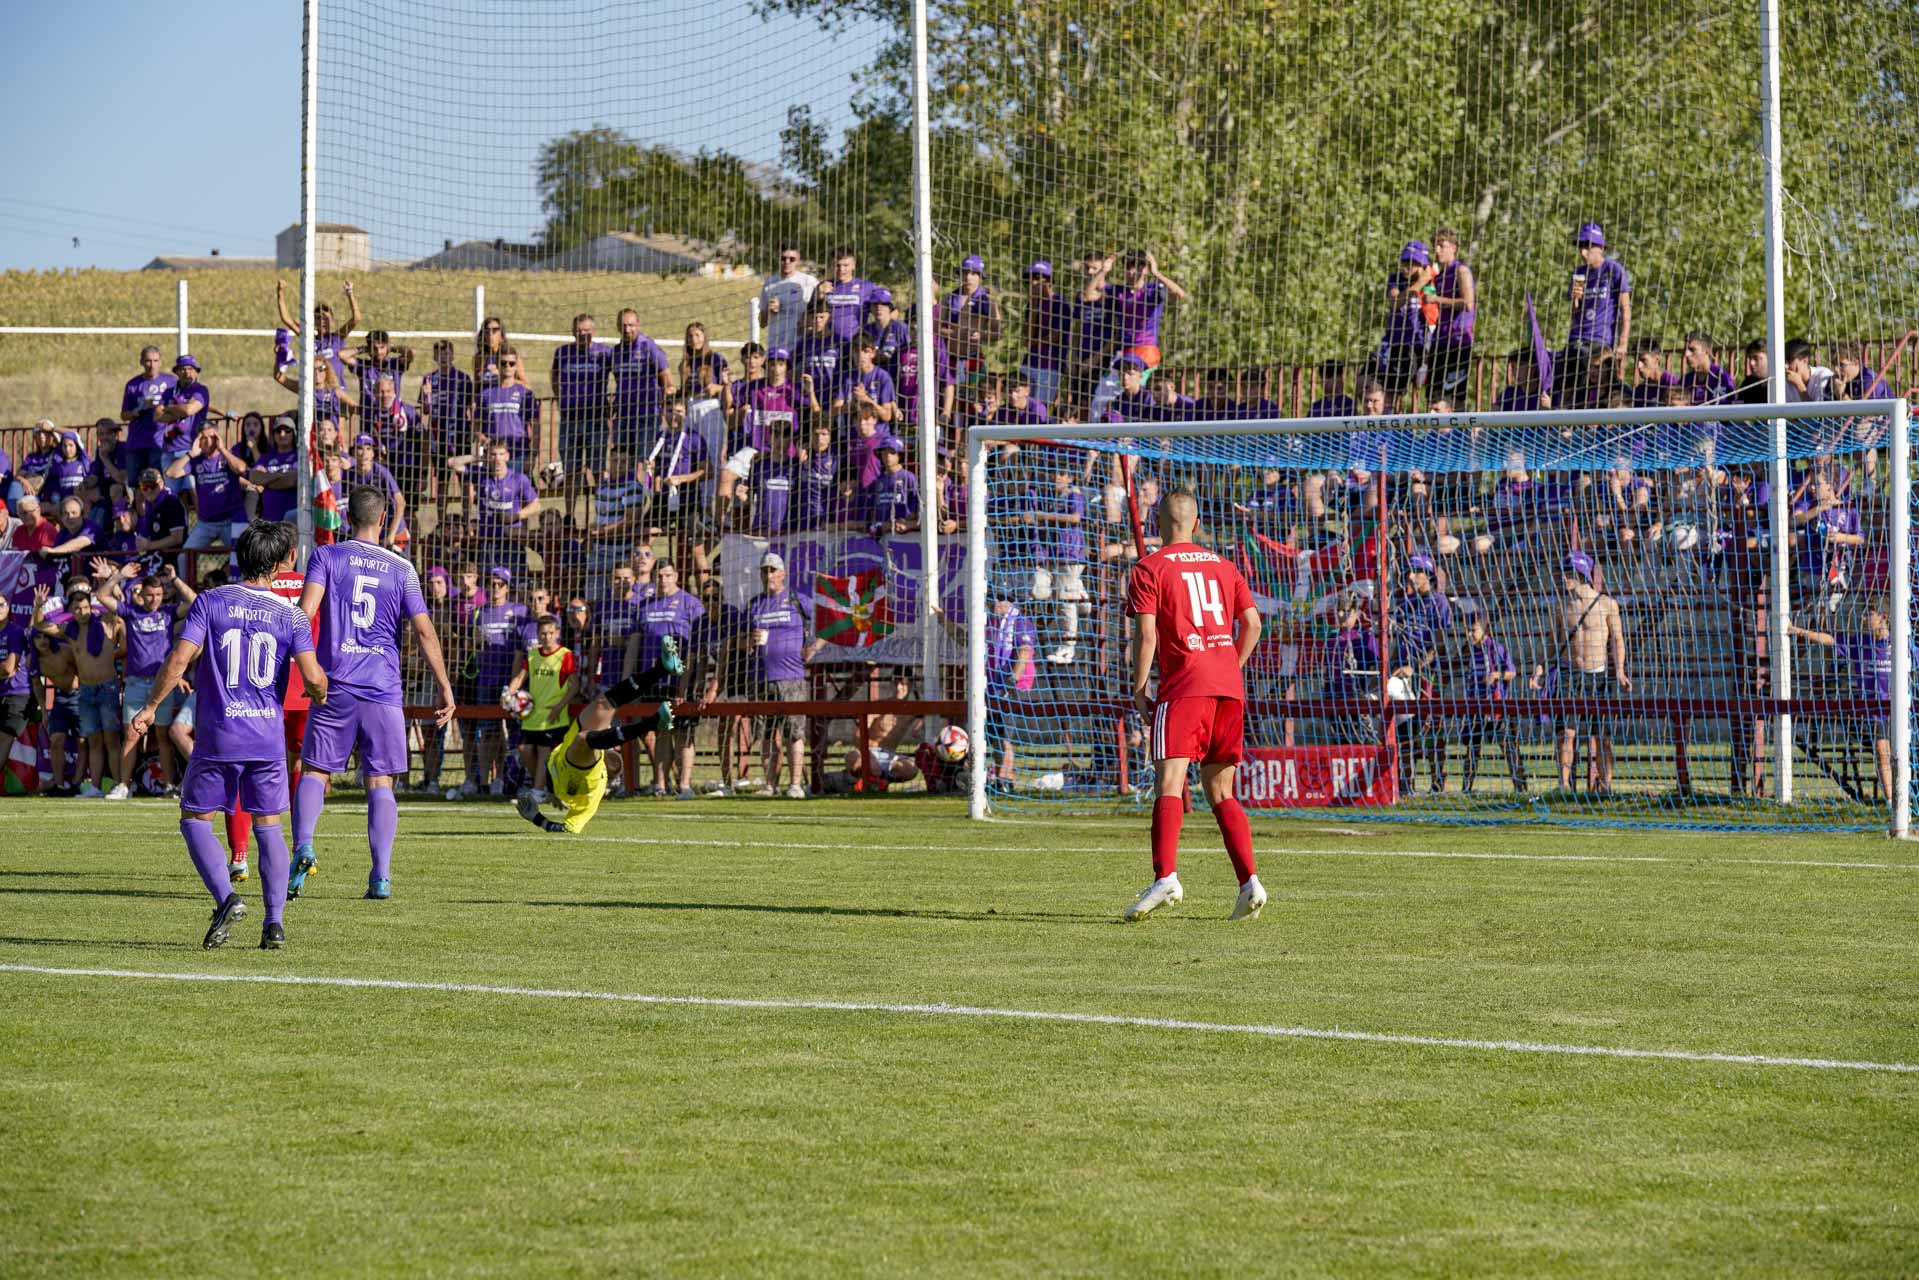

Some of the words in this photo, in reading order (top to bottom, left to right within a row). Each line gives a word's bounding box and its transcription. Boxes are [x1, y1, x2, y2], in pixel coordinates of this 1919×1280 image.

[349, 555, 389, 573] SANTURTZI
[228, 605, 273, 624] SANTURTZI
[351, 574, 379, 628] 5
[1181, 572, 1225, 627] 14
[220, 628, 278, 689] 10
[1235, 759, 1299, 801] COPA
[1332, 757, 1376, 798] REY
